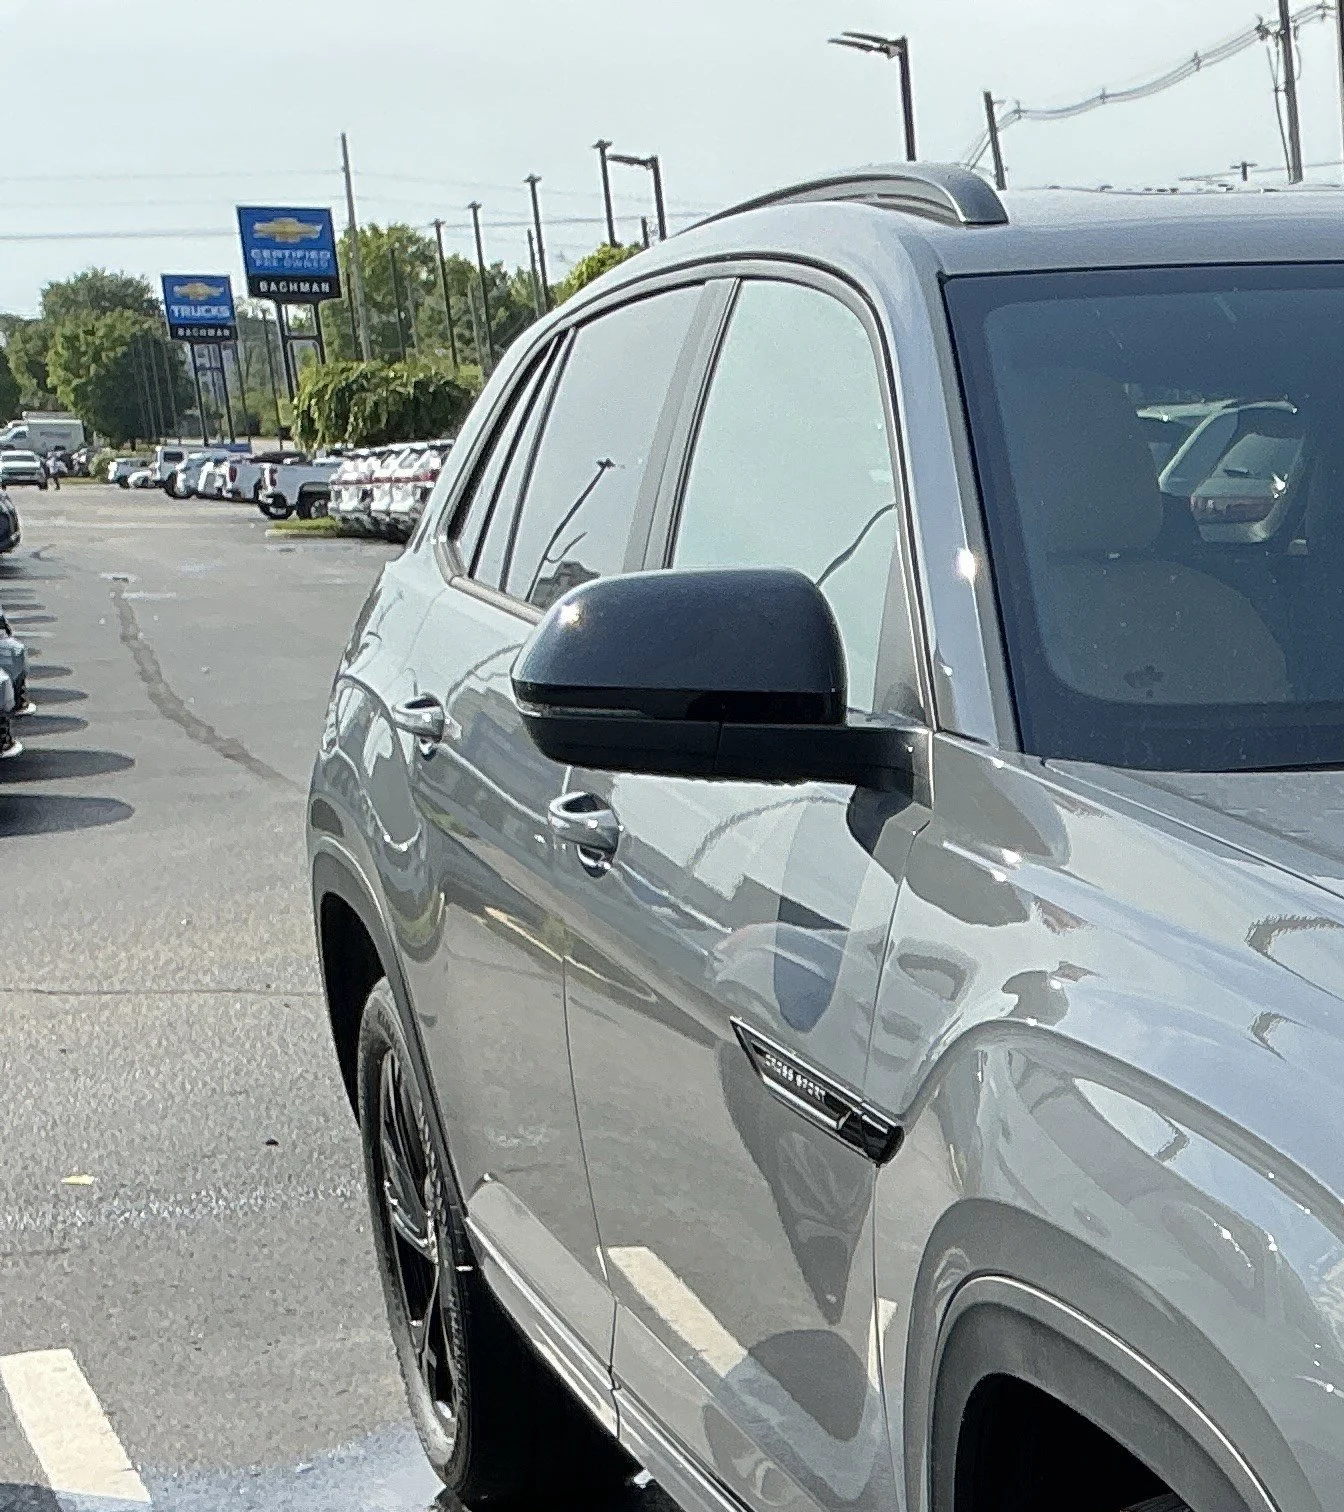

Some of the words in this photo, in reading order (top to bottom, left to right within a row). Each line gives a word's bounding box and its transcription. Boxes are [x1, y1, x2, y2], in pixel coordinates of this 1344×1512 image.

[259, 280, 330, 294] BACHMAN
[170, 305, 231, 319] TRUCKS
[177, 327, 231, 338] BACHMAN
